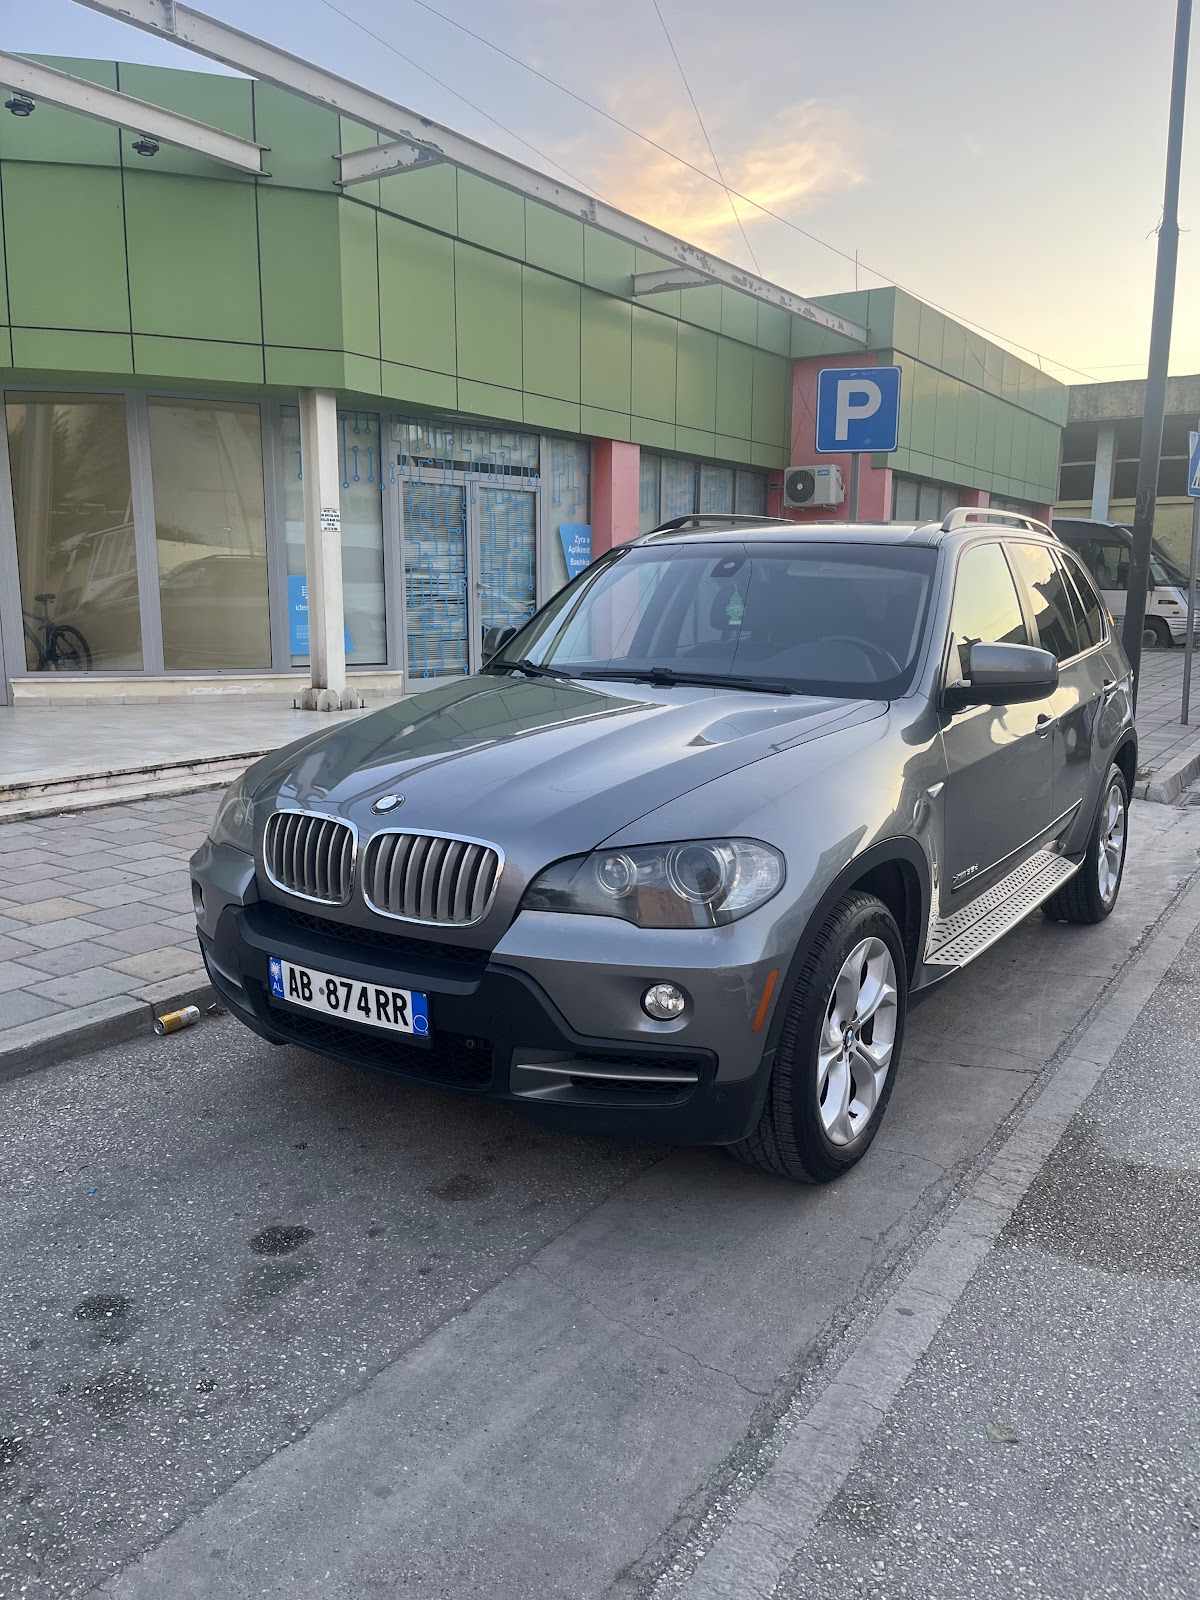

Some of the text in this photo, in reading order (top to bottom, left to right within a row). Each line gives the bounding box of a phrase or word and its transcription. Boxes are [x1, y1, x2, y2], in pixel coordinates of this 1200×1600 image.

[835, 379, 882, 441] P
[575, 535, 586, 545] Zyra
[272, 981, 283, 993] AL
[289, 966, 409, 1026] AB 874RR
